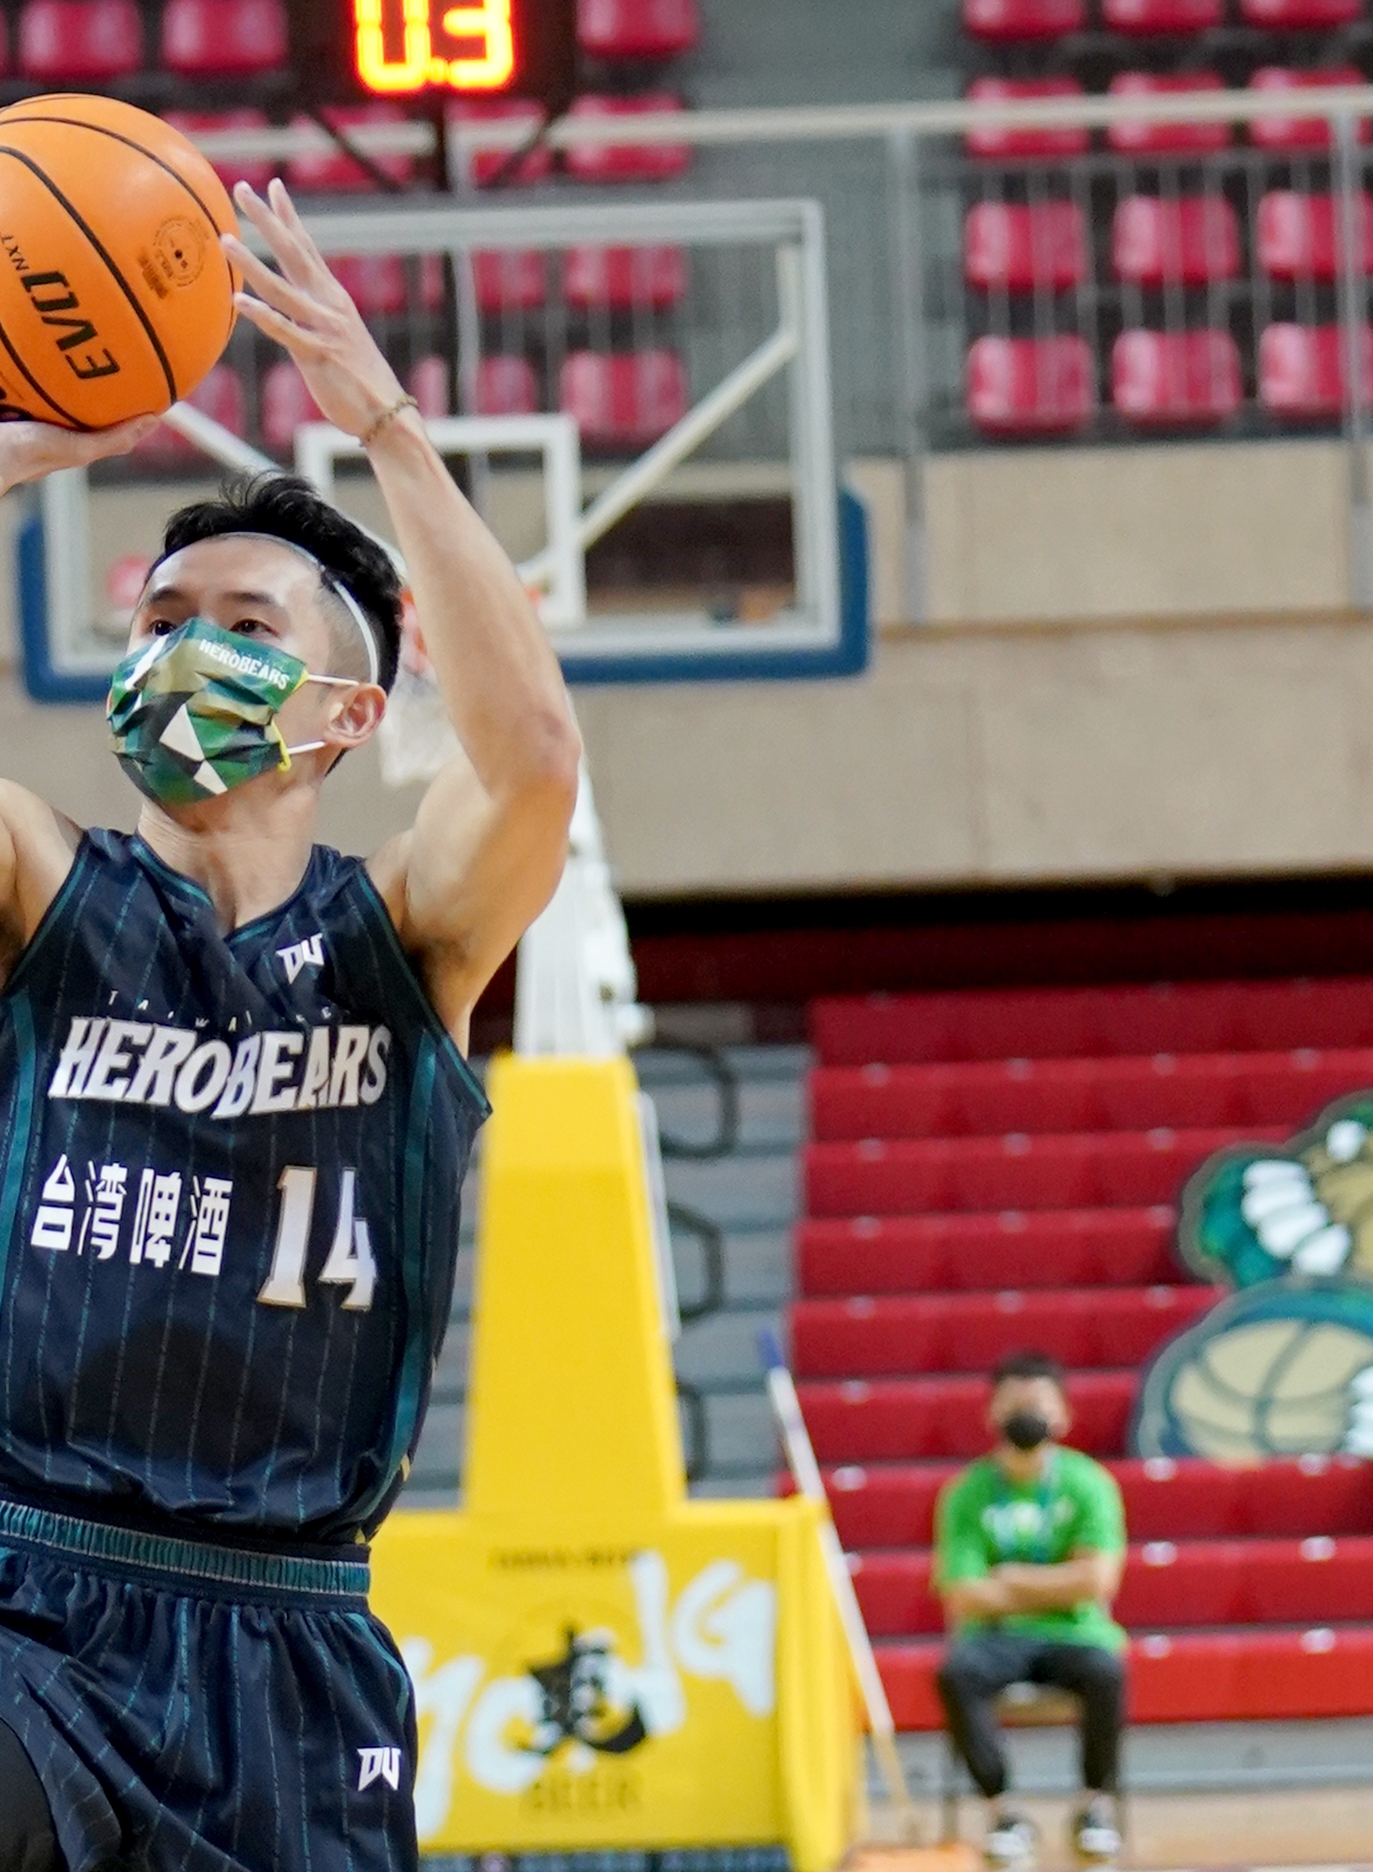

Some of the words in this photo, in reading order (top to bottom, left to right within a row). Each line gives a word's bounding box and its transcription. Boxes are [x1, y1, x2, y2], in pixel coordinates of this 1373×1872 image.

[199, 639, 291, 690] HEROBEARS
[48, 1016, 392, 1119] HEROBEARS
[255, 1165, 377, 1312] 14
